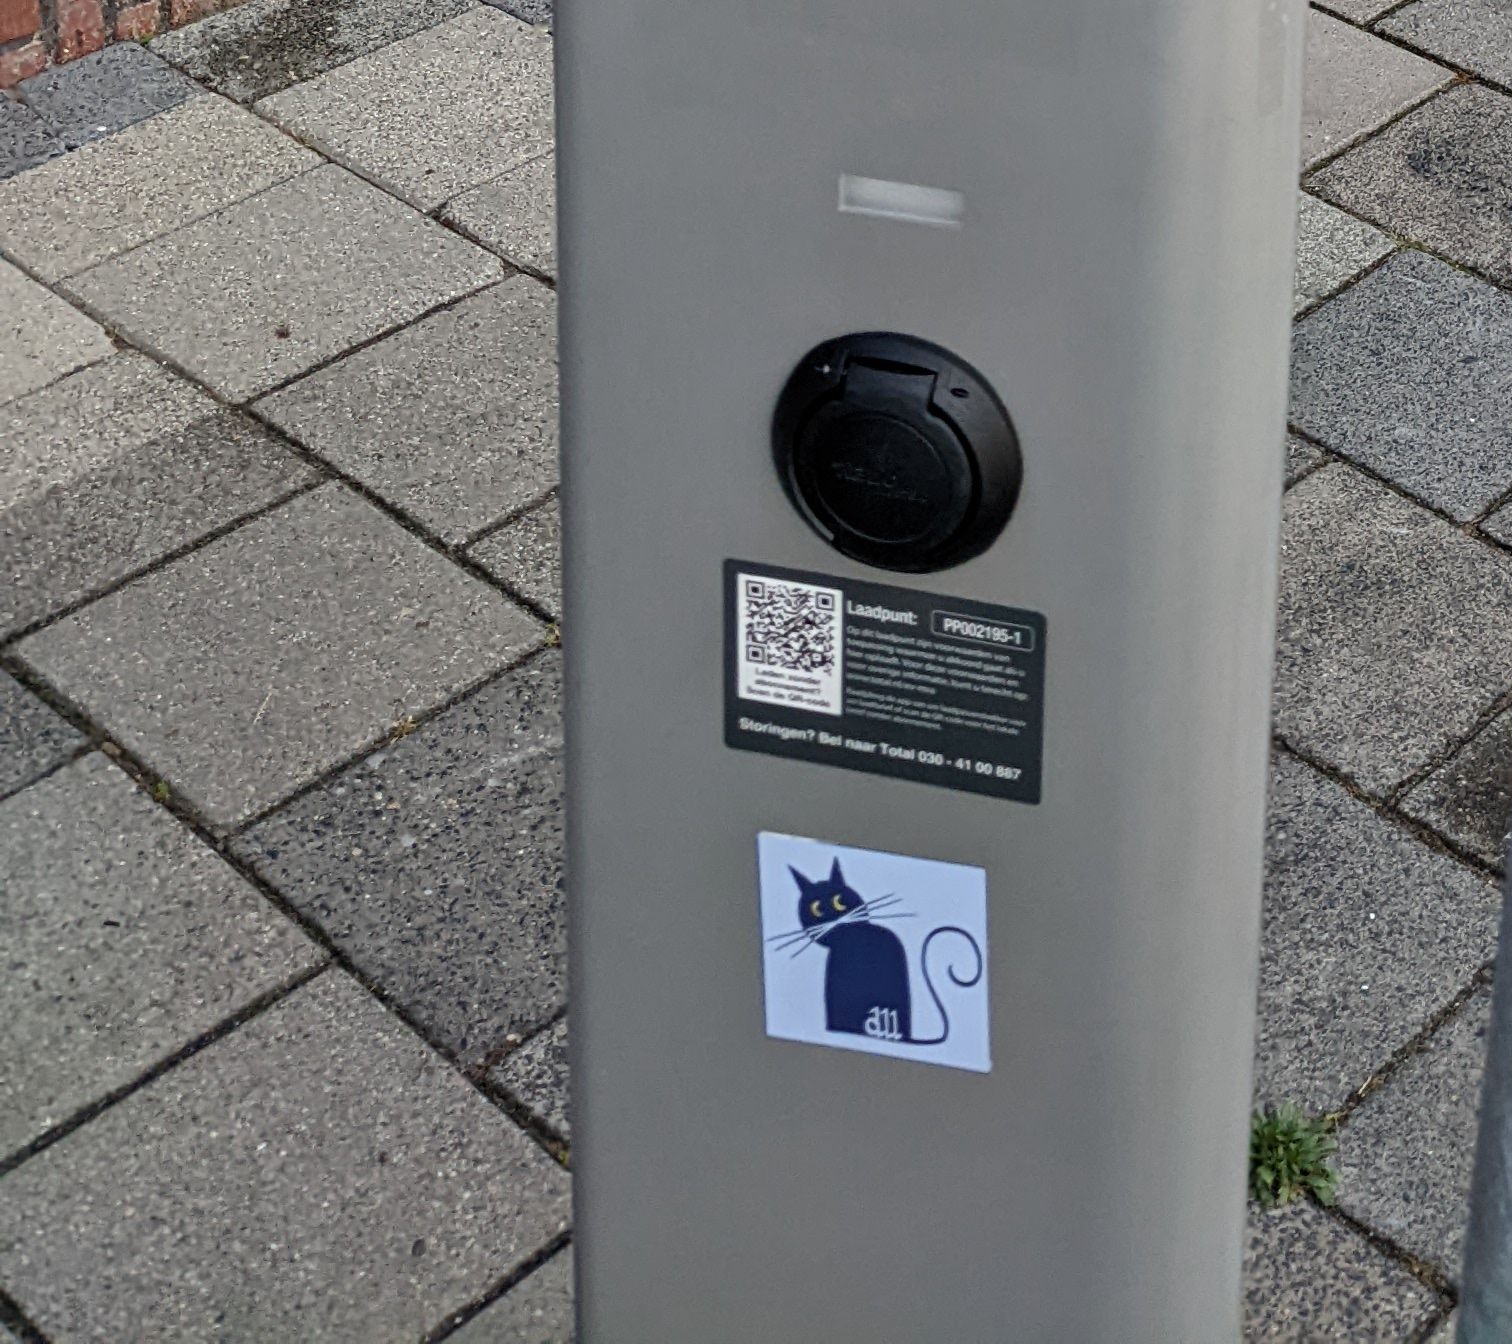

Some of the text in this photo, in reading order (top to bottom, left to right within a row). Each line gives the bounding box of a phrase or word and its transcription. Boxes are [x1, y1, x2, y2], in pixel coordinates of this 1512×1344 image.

[847, 600, 1021, 645] Laadpunt: PP002195-1
[738, 716, 814, 741] Storingen?
[818, 732, 842, 747] Bel
[845, 739, 877, 753] naar
[880, 742, 915, 760] Total
[918, 750, 944, 766] 030
[955, 758, 971, 770] 41
[975, 761, 993, 775] 00
[996, 765, 1022, 780] 887
